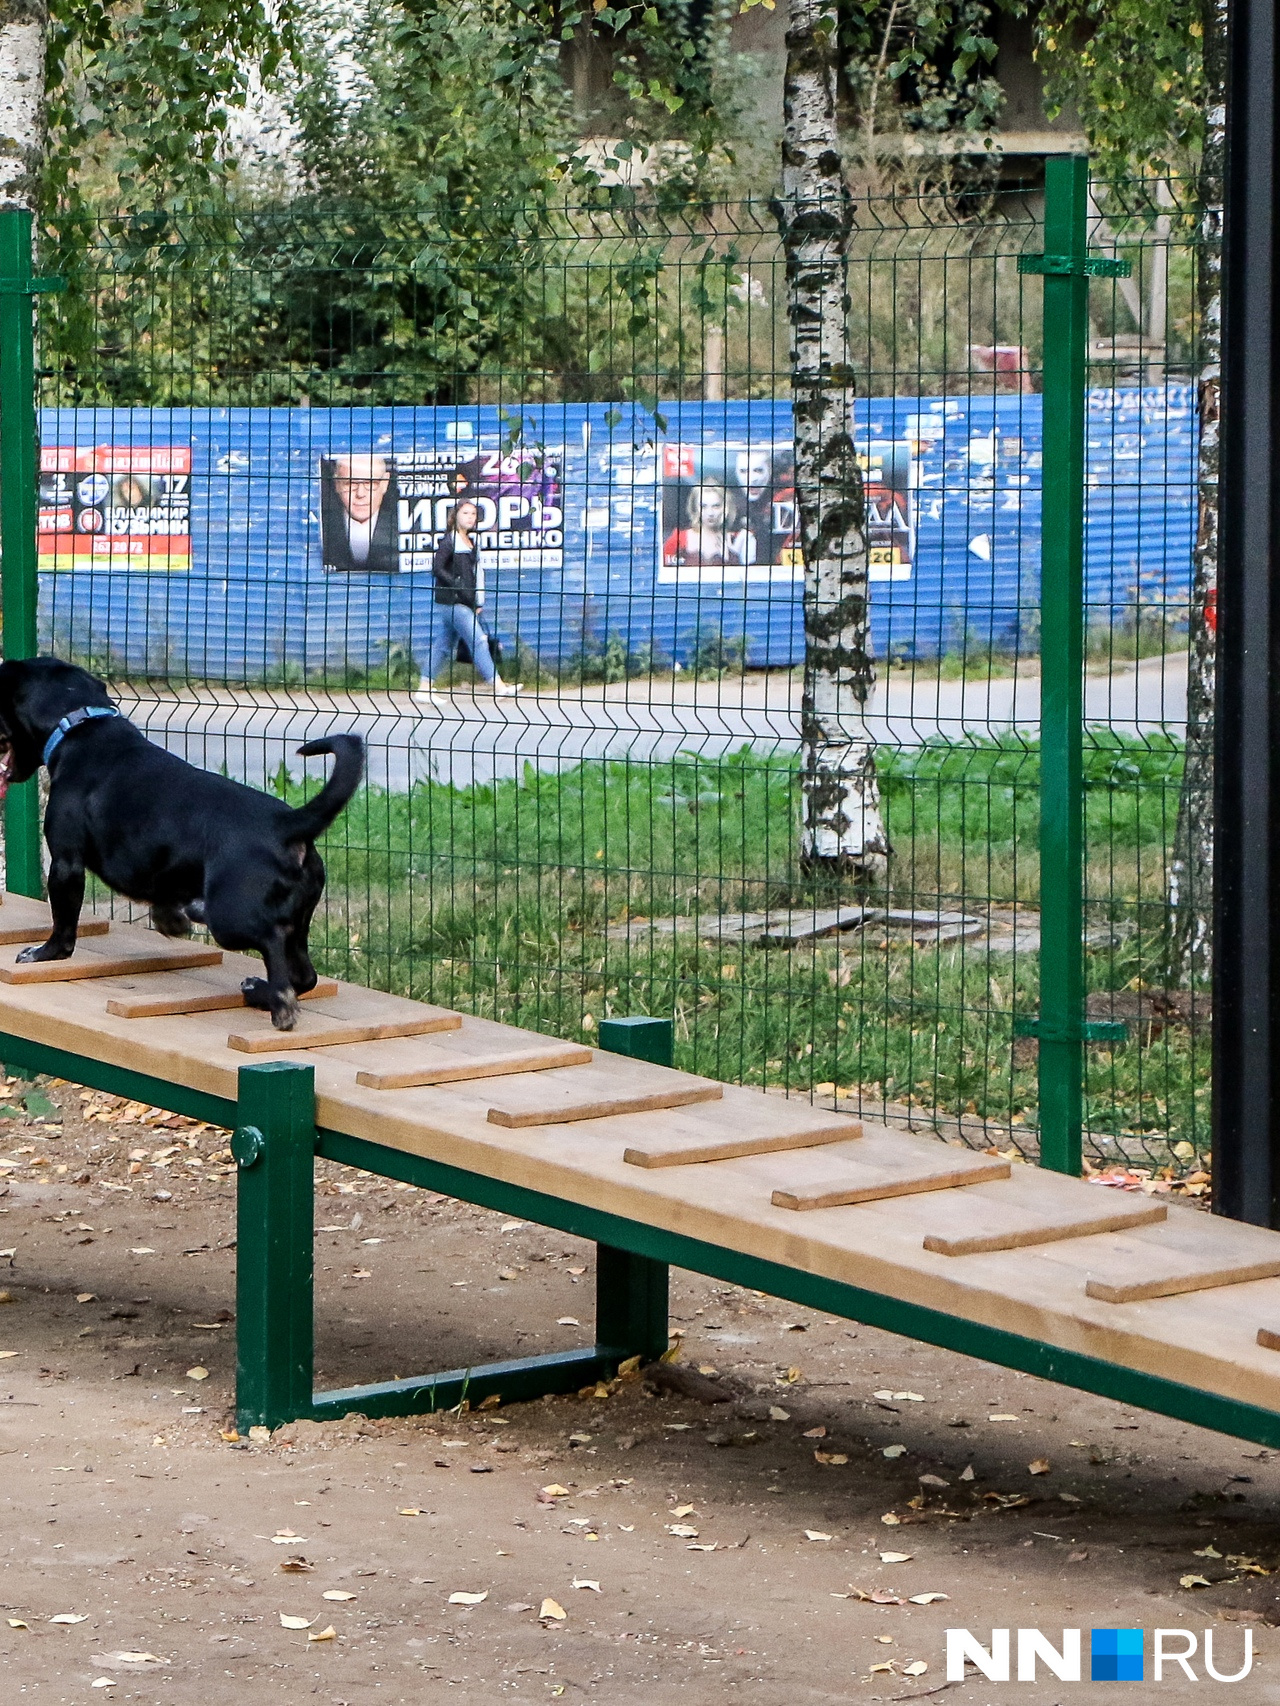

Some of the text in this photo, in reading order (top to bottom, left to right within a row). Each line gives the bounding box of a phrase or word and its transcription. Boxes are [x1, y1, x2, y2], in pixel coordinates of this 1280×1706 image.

[104, 452, 184, 469] maximilian
[164, 474, 189, 493] 17
[397, 483, 451, 497] ТАЙНА
[105, 506, 189, 520] ВЛАДИМИР
[397, 496, 563, 533] ИГОРЬ
[105, 519, 189, 535] КУЗЬМИН
